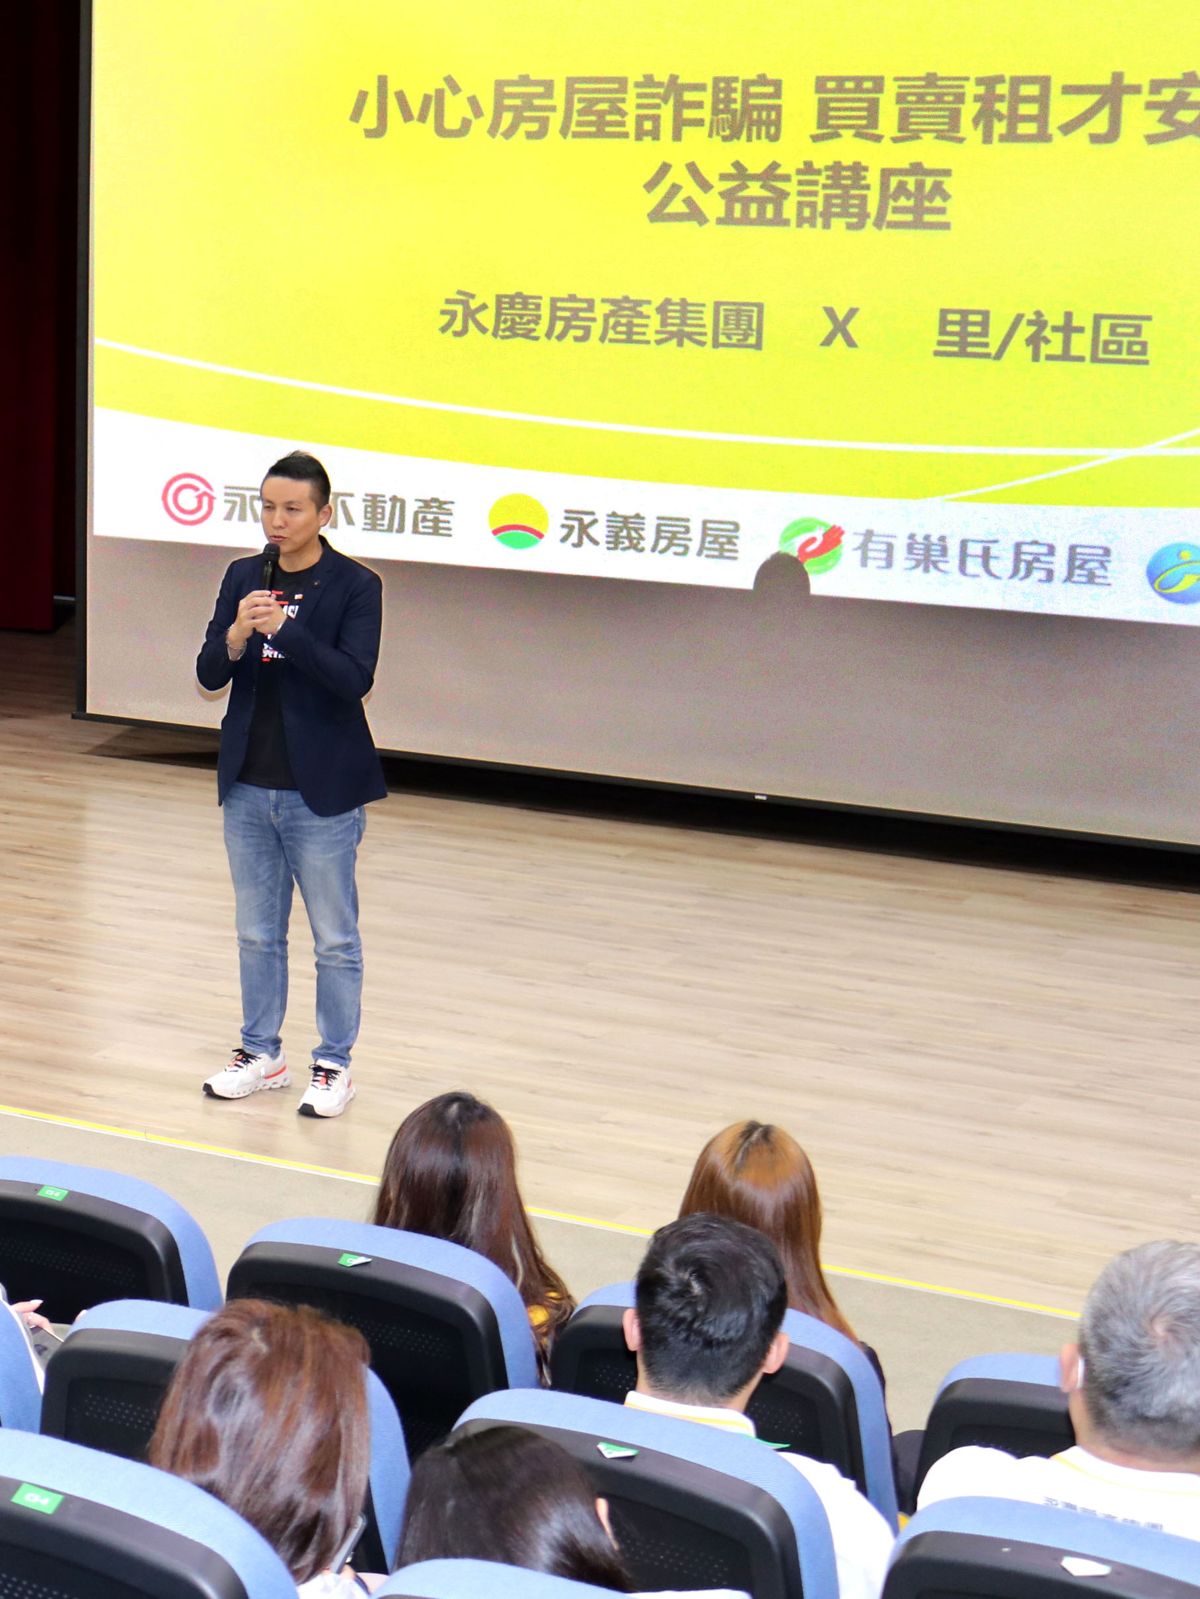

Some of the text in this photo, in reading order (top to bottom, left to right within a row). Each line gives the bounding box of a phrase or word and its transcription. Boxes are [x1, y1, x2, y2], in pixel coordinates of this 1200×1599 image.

[348, 71, 1200, 146] 小心房屋詐騙 買賣租才安
[642, 159, 953, 232] 公益講座
[438, 289, 1153, 367] 永慶房產集團 X 里/社區
[223, 485, 455, 538] 永不動產
[559, 508, 741, 562] 永義房屋
[853, 528, 1113, 587] 有巢氏房屋
